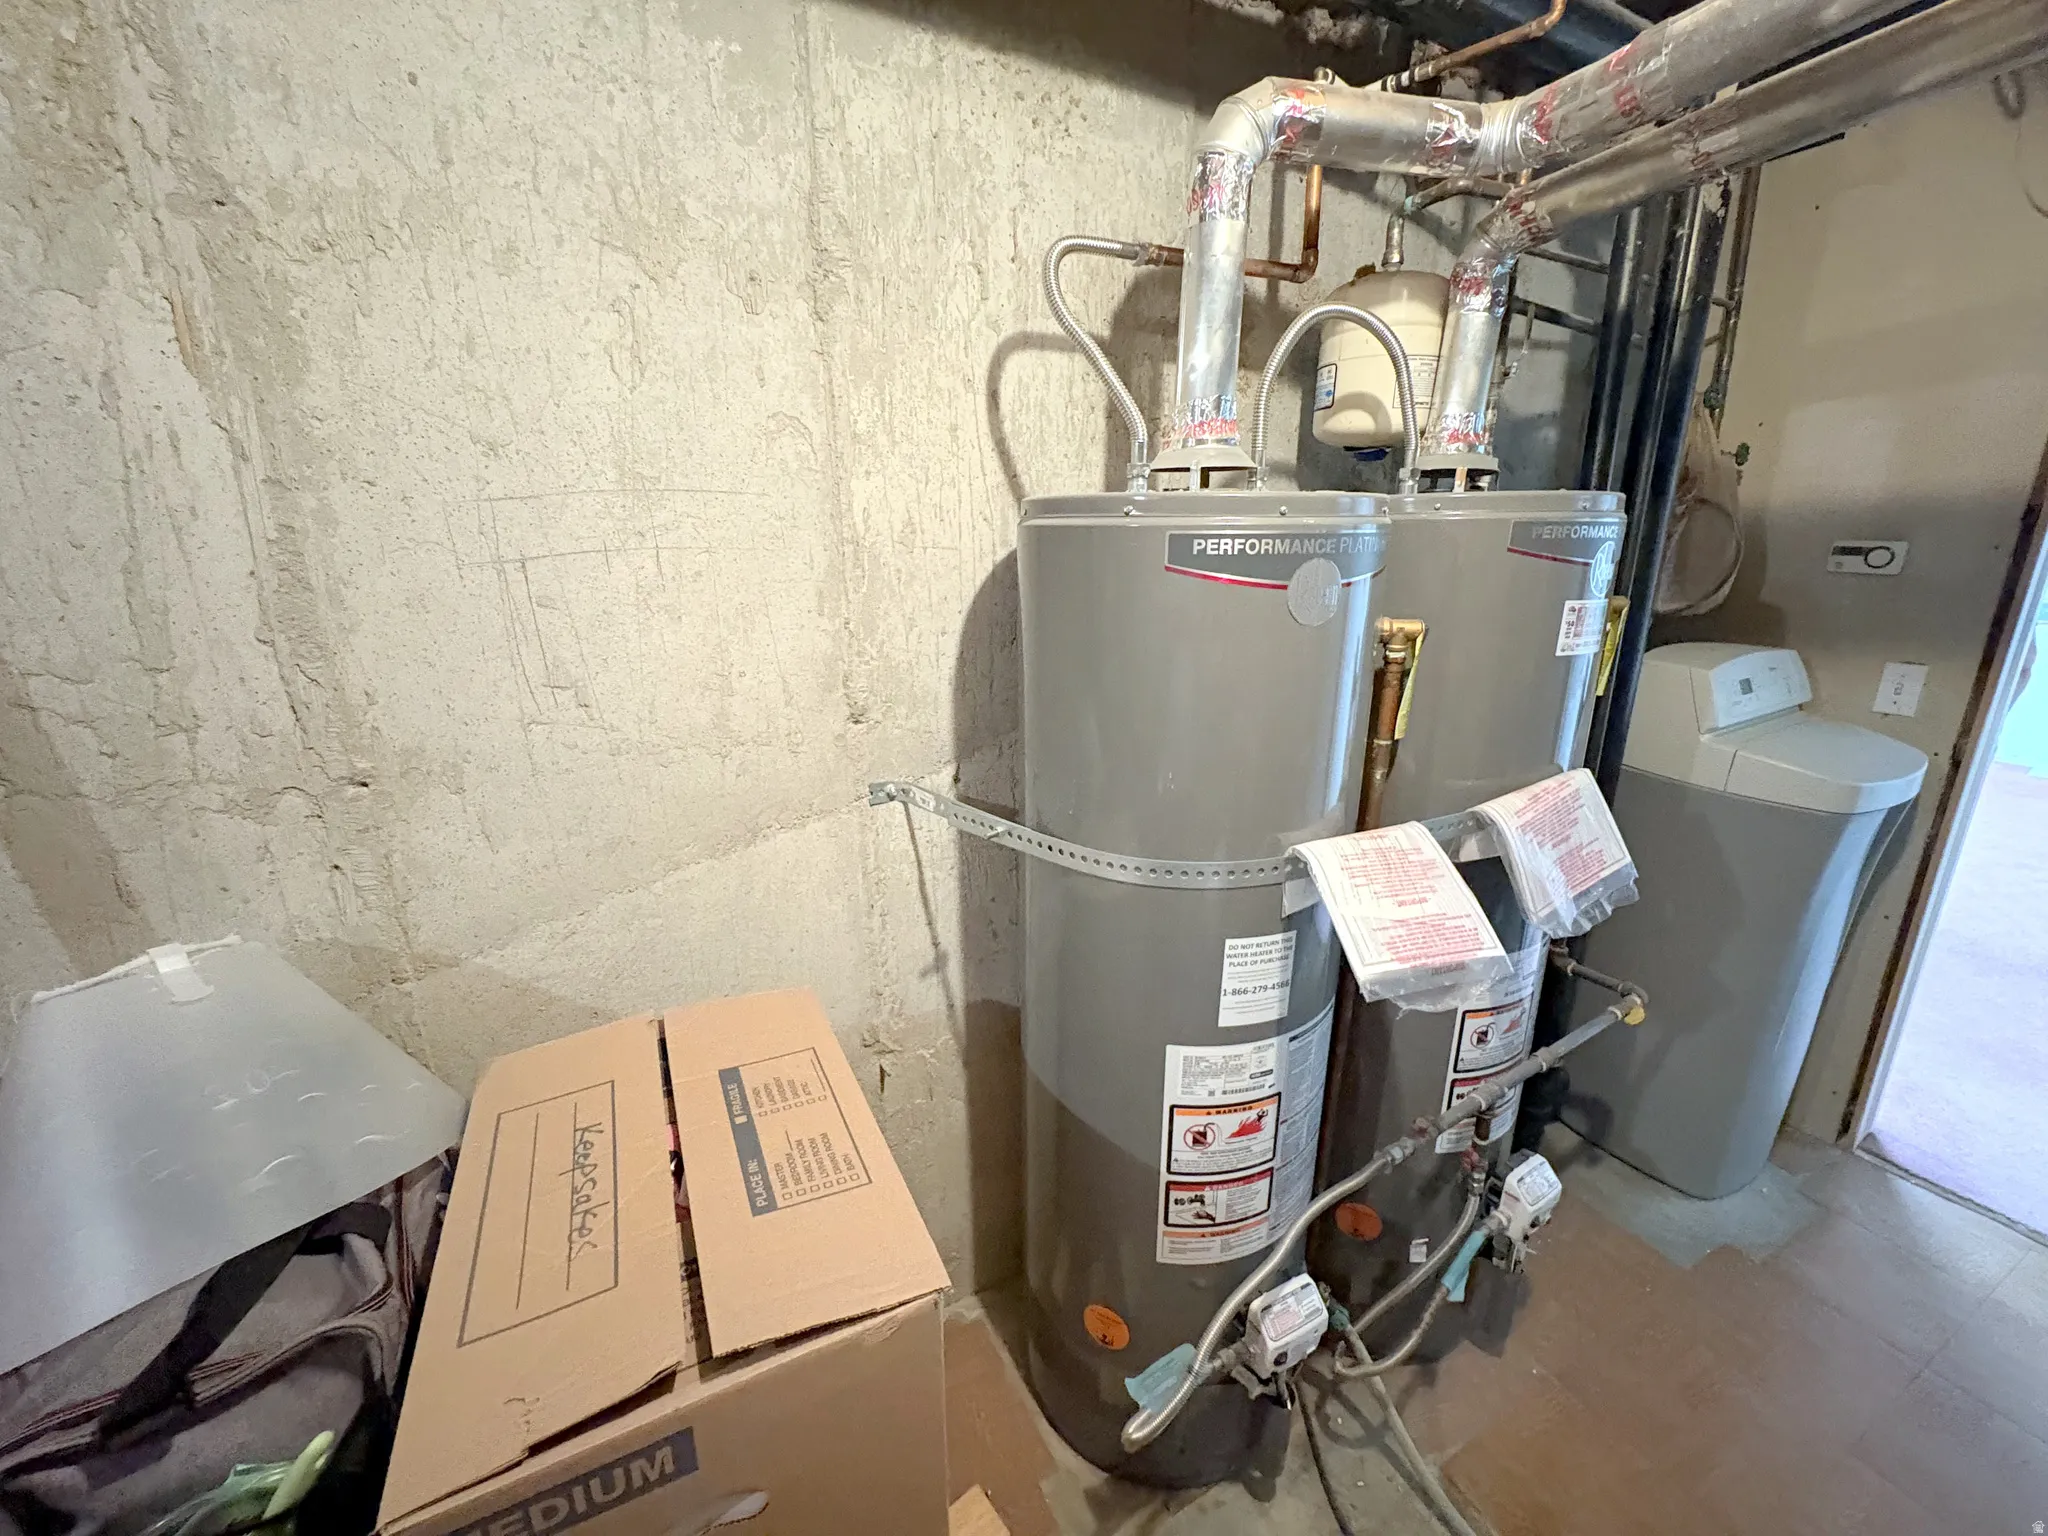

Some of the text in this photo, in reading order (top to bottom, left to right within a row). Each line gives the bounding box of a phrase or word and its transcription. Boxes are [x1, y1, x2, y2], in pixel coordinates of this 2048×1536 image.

[1192, 537, 1335, 555] PERFORMANCE
[1532, 525, 1619, 539] PERFORMANCE
[1226, 951, 1249, 959] WATER
[1250, 948, 1273, 956] HEATER
[1255, 940, 1280, 948] RETURN
[728, 1083, 743, 1115] FRAGILE
[795, 1139, 817, 1182] FAMILY ROOM
[808, 1137, 829, 1179] LIVING ROOM
[820, 1132, 842, 1174] DINING ROOM
[842, 1154, 855, 1171] BATH
[747, 1159, 768, 1207] PLACE IN:
[774, 1162, 789, 1189] MASTER
[464, 1445, 675, 1536] EDIUM
